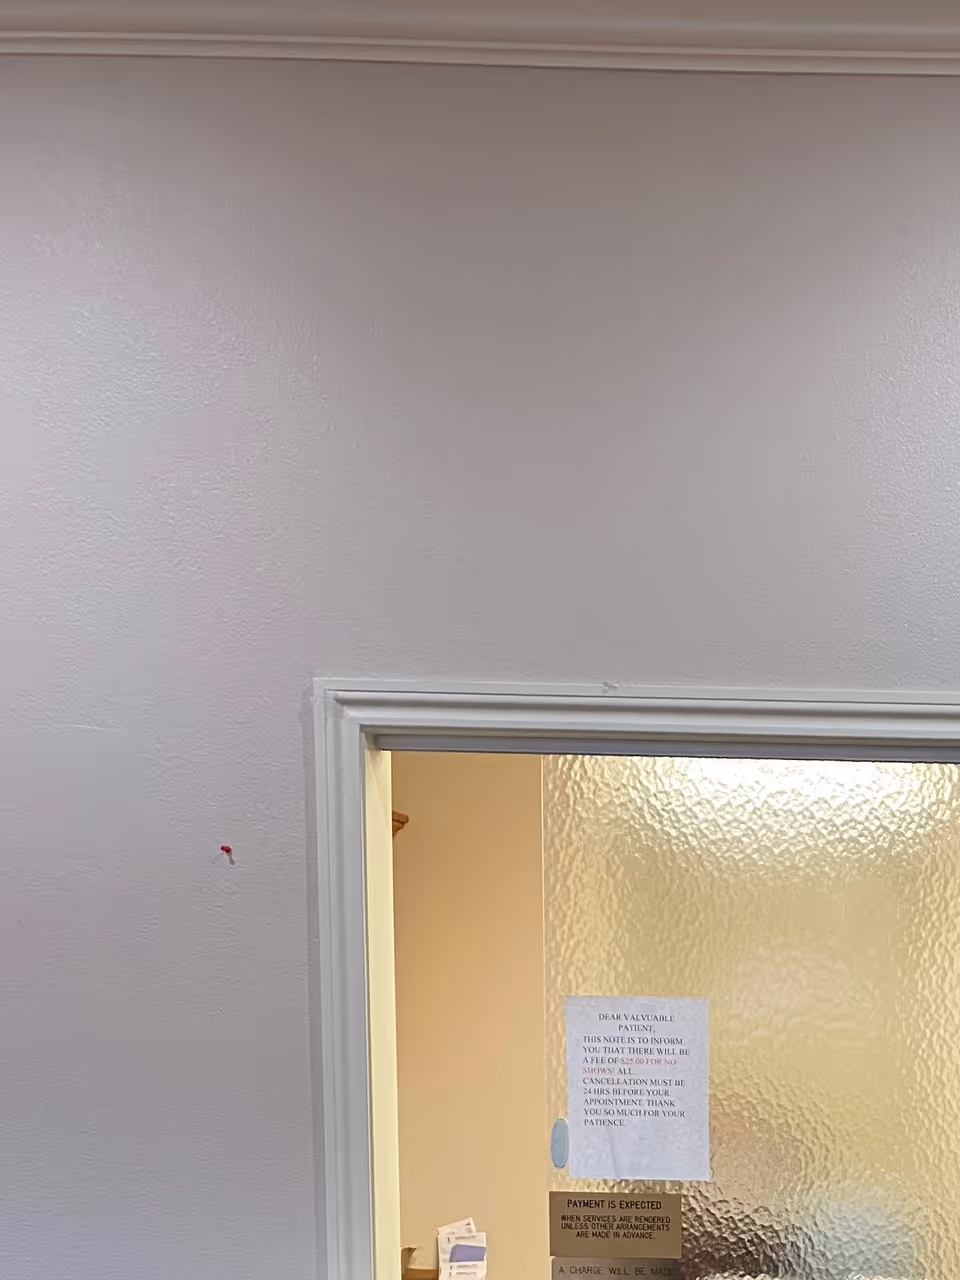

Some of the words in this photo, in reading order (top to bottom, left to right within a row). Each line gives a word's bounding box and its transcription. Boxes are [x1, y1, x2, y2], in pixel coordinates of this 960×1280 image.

[599, 1013, 622, 1021] DEAR
[624, 1014, 675, 1022] VALVUABLE
[618, 1024, 656, 1033] PATIENT,
[583, 1046, 601, 1054] YOU
[603, 1046, 625, 1054] THAT
[583, 1077, 647, 1086] CANCELLATION
[675, 1079, 686, 1087] BE
[584, 1087, 592, 1095] 24
[612, 1088, 644, 1096] BEFORE
[646, 1099, 676, 1107] THANK
[584, 1108, 602, 1116] YOU
[617, 1109, 642, 1117] MUCH
[567, 1199, 604, 1209] PAYMENT
[608, 1201, 616, 1209] IS
[619, 1201, 662, 1210] EXPECTED
[583, 1215, 616, 1223] SERVICES
[635, 1216, 671, 1224] RENDERED
[615, 1223, 670, 1231] ARRANGEMENTS
[559, 1266, 564, 1274] A
[570, 1266, 602, 1274] CHARGE
